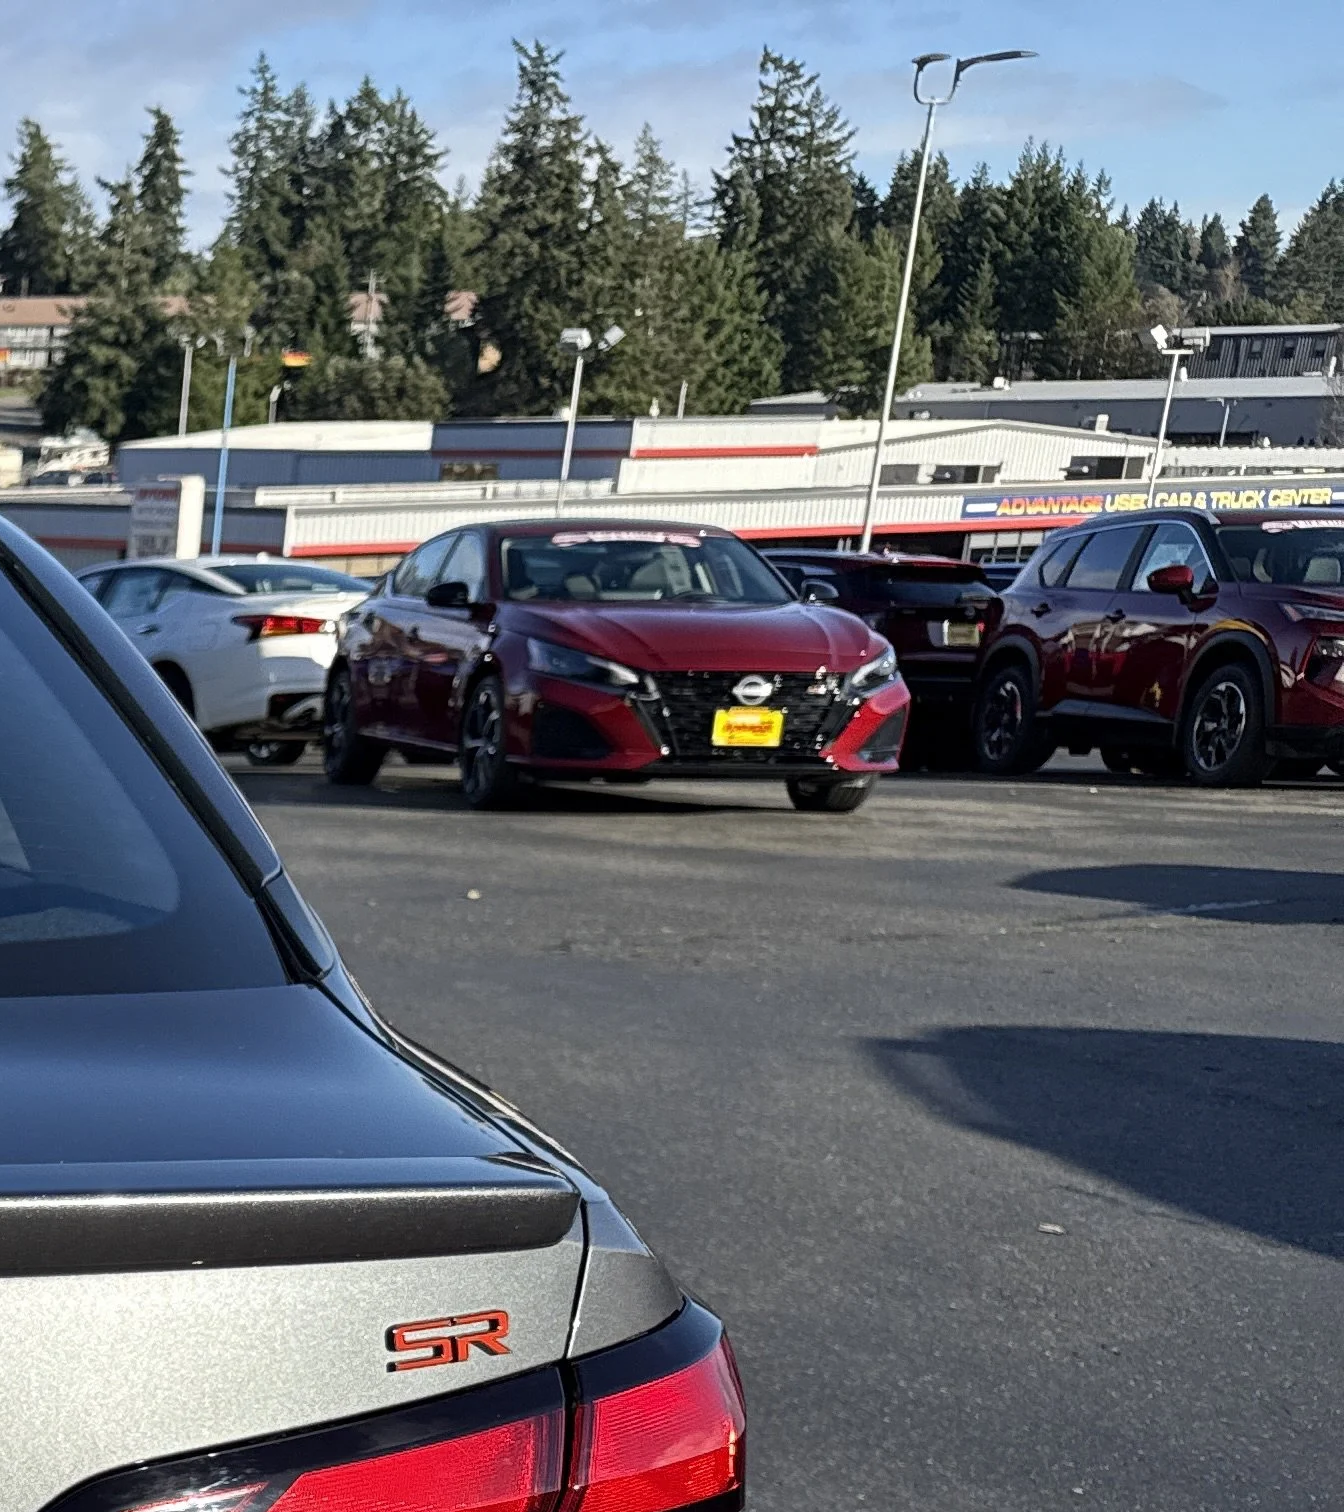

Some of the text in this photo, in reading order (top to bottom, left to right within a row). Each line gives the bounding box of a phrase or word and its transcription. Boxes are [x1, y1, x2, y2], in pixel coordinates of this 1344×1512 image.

[996, 497, 1103, 516] ADVANTAGE
[1210, 489, 1265, 509] TRUCK
[1268, 487, 1332, 507] CENTER
[385, 1309, 511, 1372] SR
